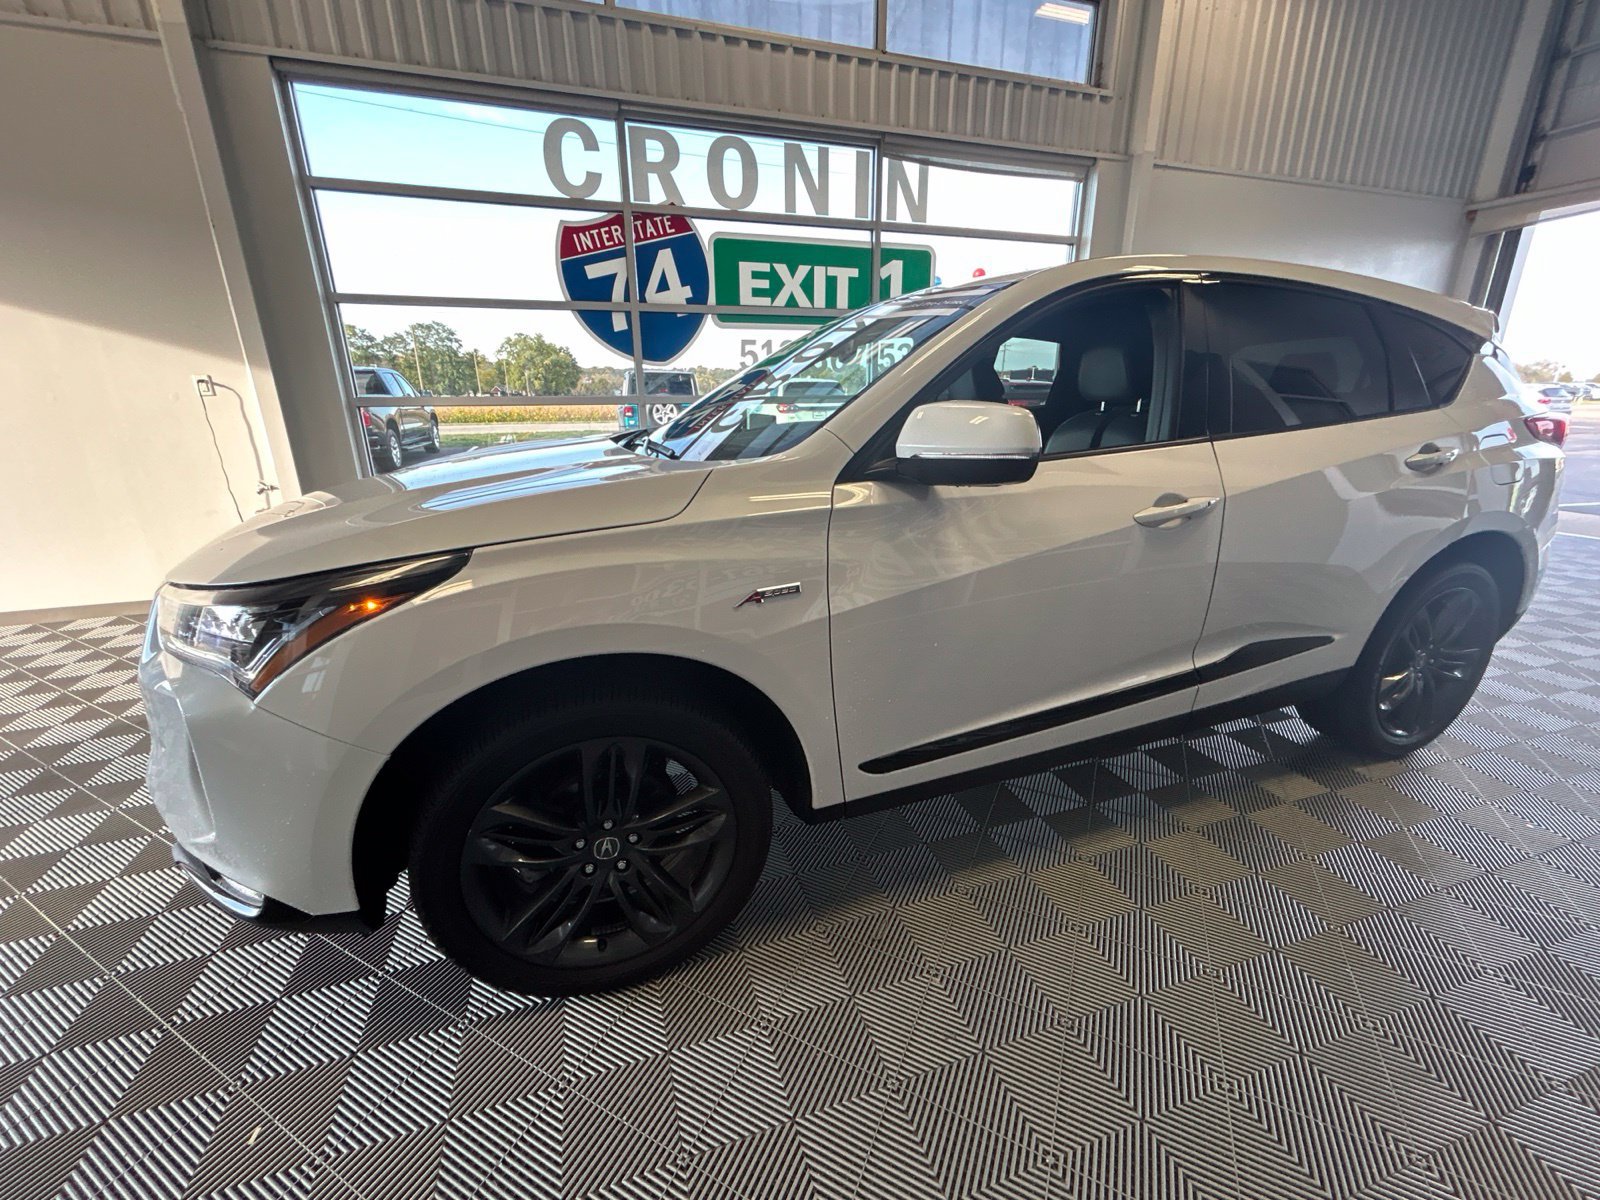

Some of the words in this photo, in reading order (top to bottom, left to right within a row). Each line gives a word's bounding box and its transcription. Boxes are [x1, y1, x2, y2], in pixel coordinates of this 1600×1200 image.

[543, 118, 930, 223] CRONIN
[573, 215, 676, 252] INTERTATE
[584, 247, 693, 332] 74
[739, 261, 859, 309] EXIT
[880, 259, 904, 299] 1
